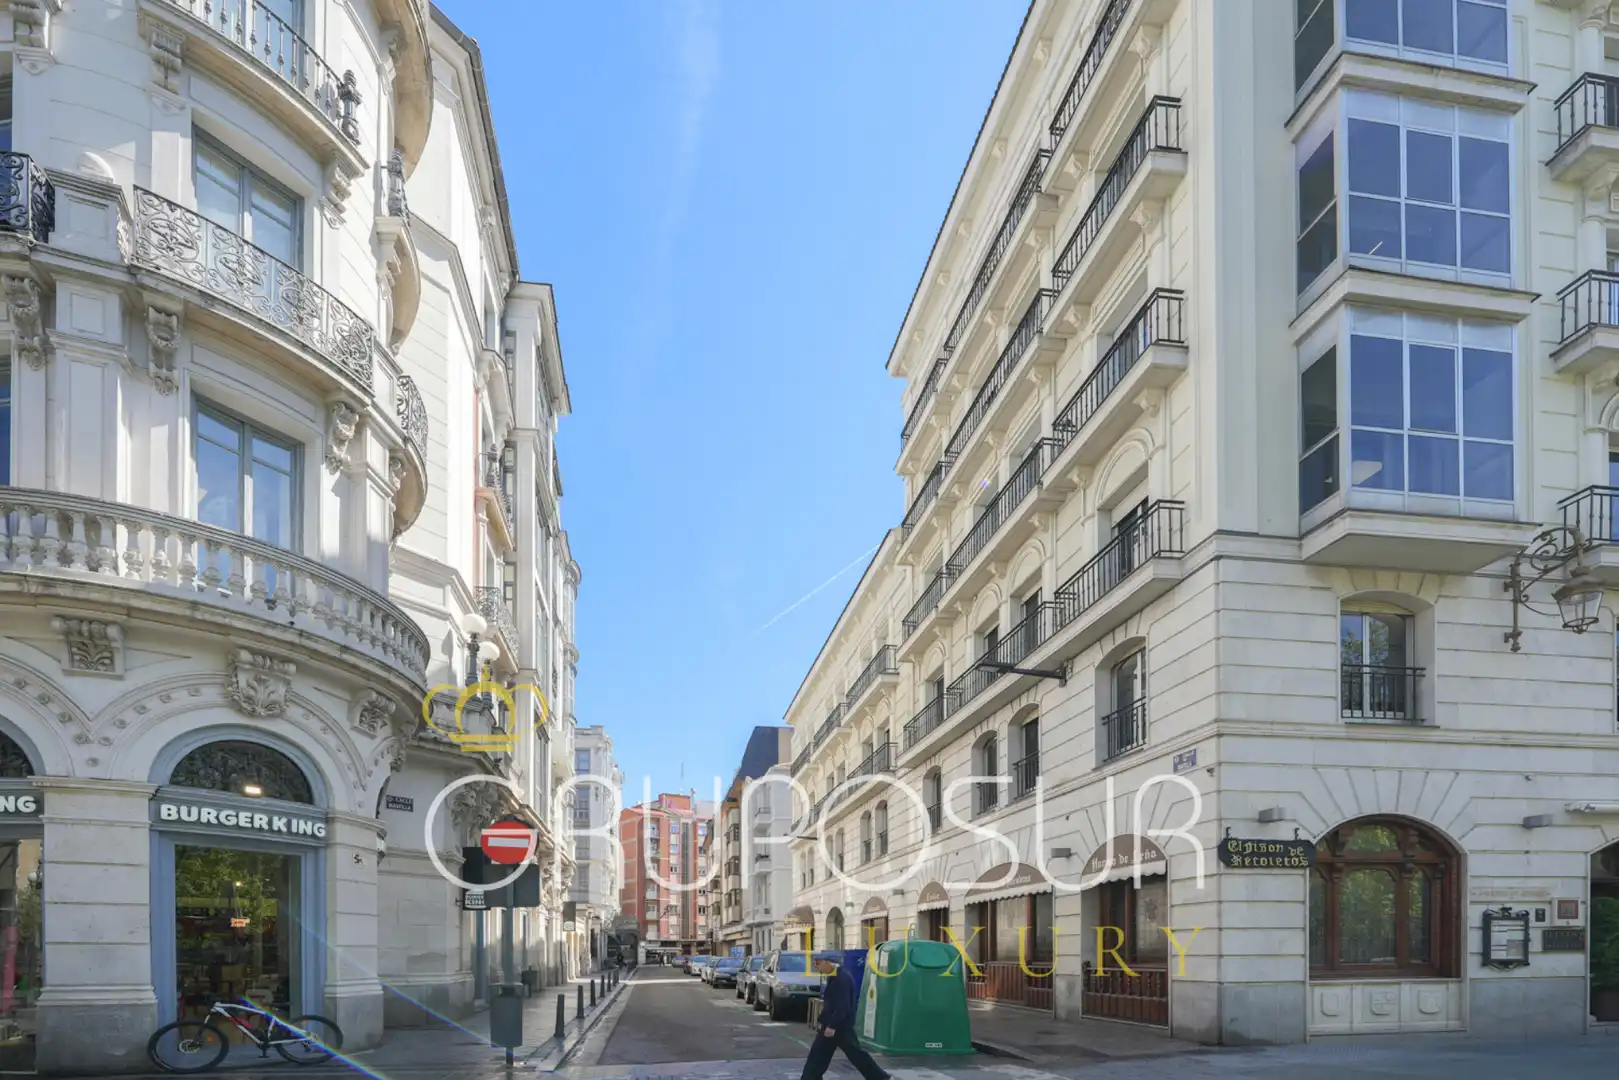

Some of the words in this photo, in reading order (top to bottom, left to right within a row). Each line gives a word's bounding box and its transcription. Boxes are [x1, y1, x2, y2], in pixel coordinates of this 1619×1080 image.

[160, 804, 269, 830] BURGER
[272, 816, 326, 837] KING
[1288, 846, 1304, 857] de
